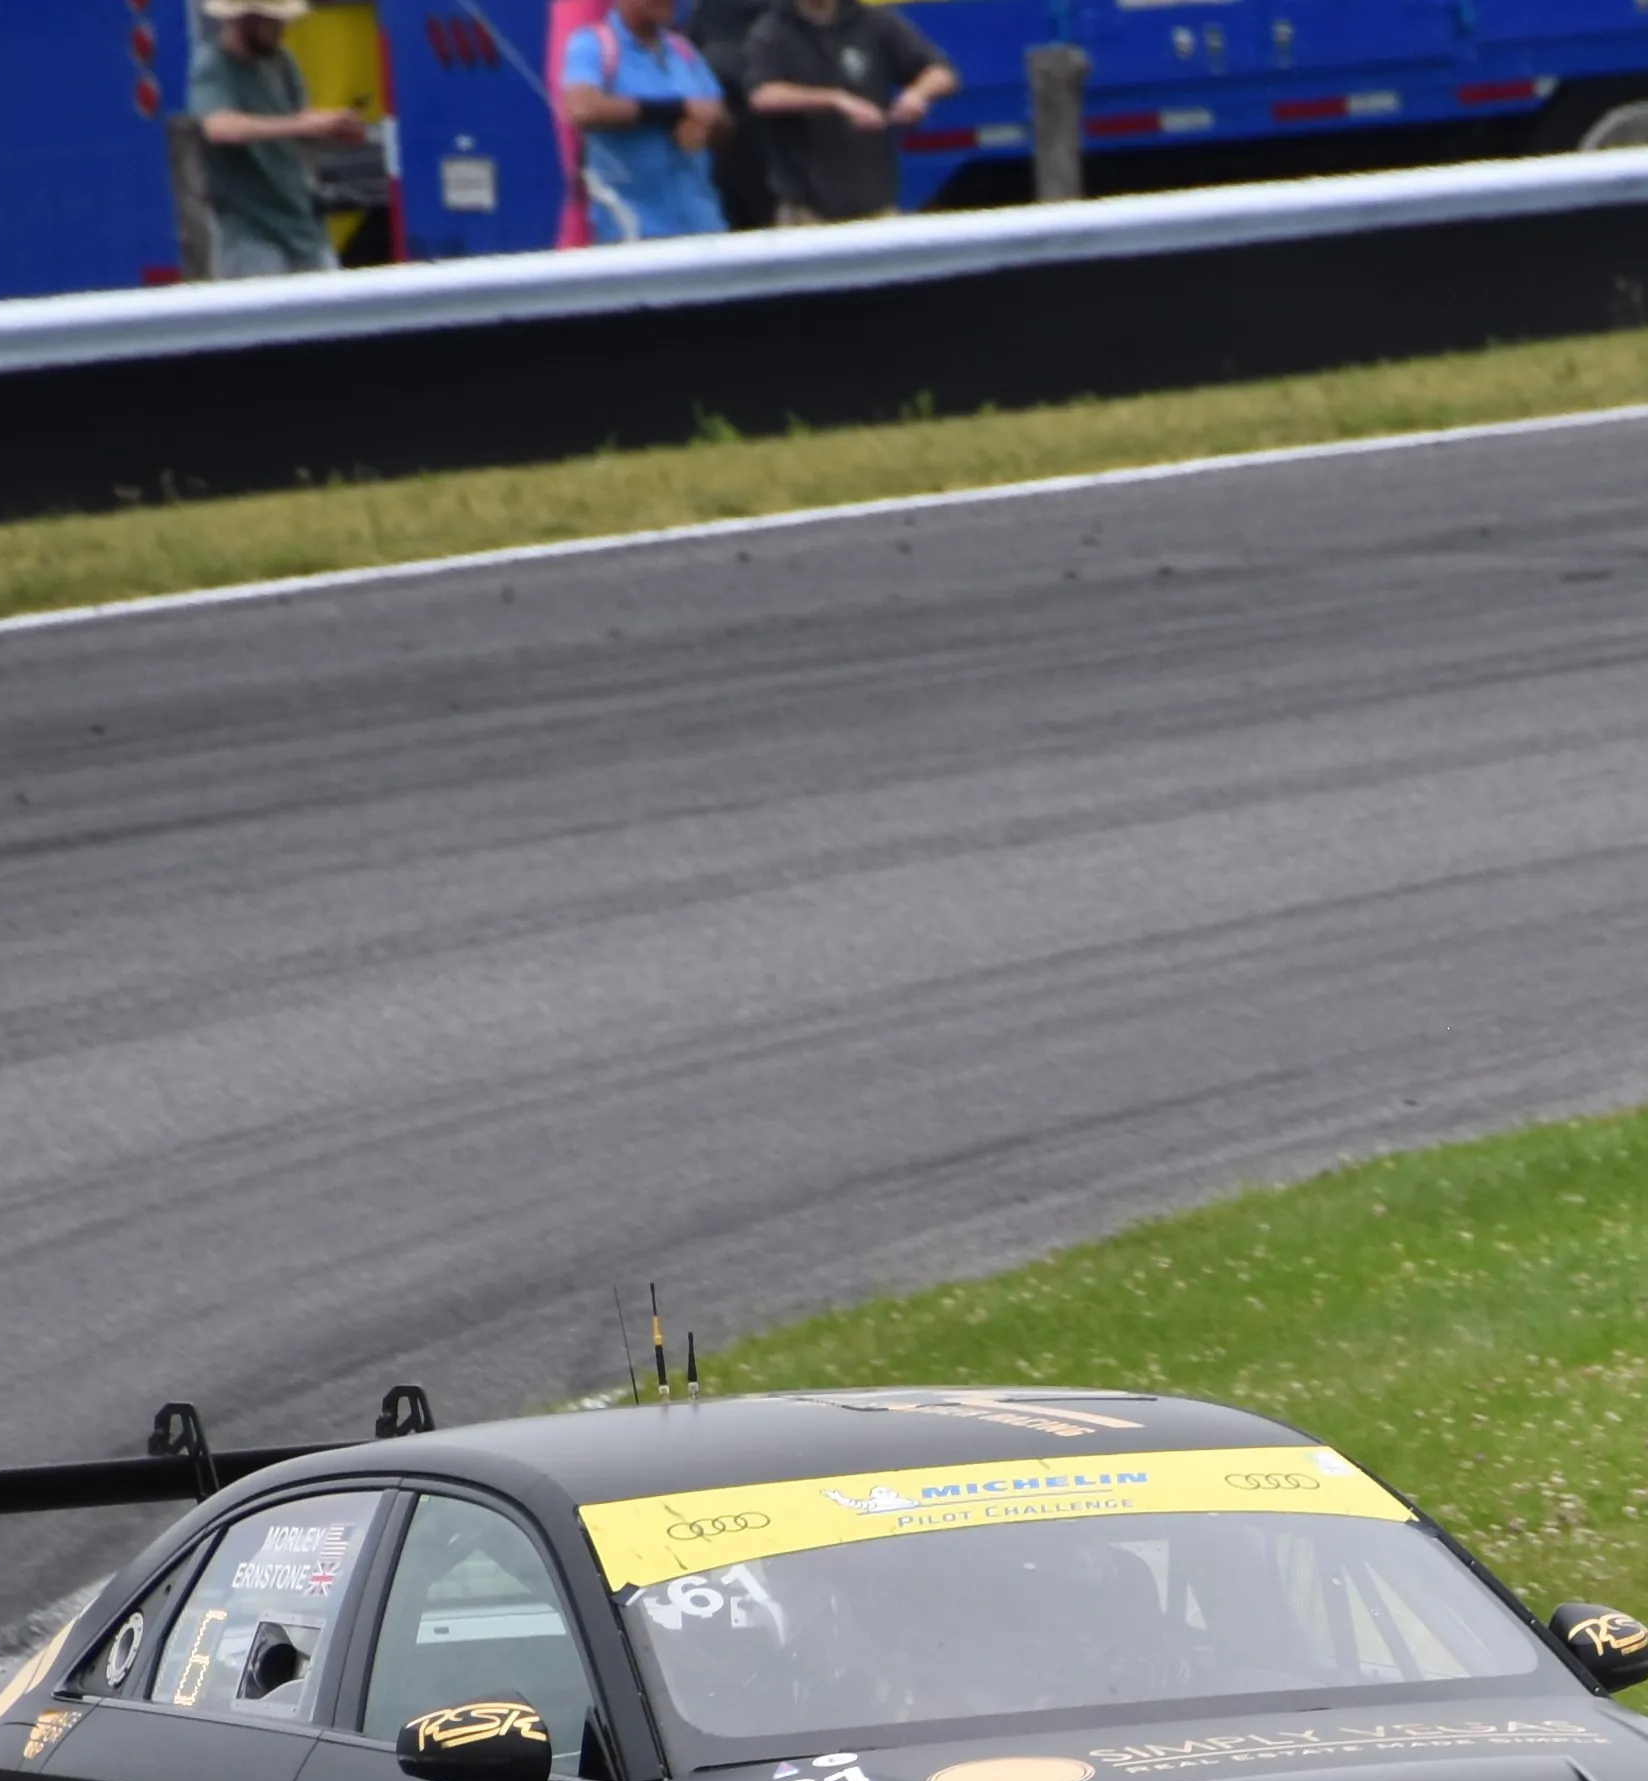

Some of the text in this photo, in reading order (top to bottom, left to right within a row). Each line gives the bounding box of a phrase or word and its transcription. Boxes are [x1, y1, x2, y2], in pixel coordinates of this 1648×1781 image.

[921, 1472, 1149, 1499] MICHELIN
[897, 1497, 1135, 1528] PILOT CHALLENGE
[260, 1525, 328, 1553] MORLEY
[232, 1561, 312, 1591] ERNSTONE
[666, 1562, 772, 1619] 61
[1089, 1720, 1587, 1763] SIMPLY VEGAS
[1125, 1759, 1221, 1775] REAL
